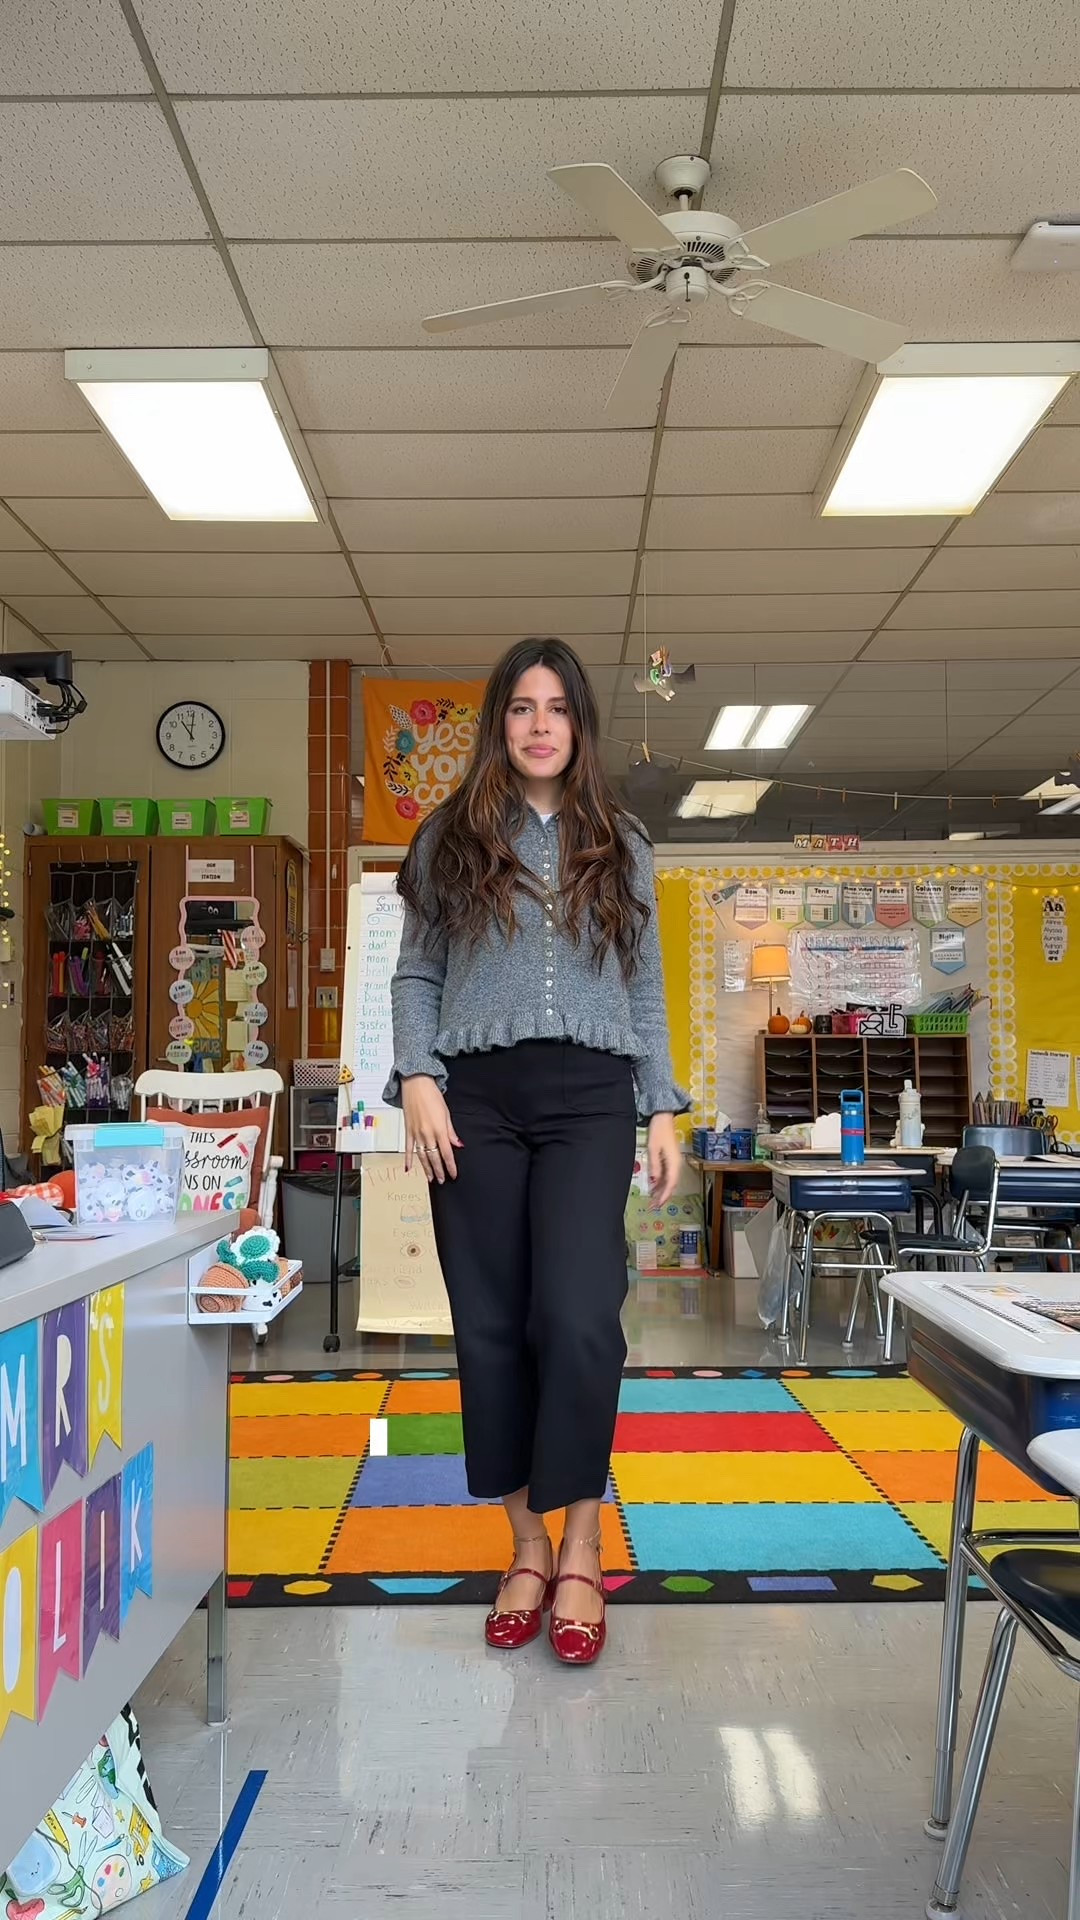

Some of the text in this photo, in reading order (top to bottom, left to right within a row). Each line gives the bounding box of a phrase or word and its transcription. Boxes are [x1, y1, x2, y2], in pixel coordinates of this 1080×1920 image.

[201, 712, 204, 720] 1
[208, 720, 214, 728] 2
[165, 732, 172, 740] 9
[212, 731, 217, 739] 3
[169, 743, 175, 751] 8
[209, 743, 215, 751] 4
[178, 751, 183, 759] 7
[413, 782, 450, 805] ca
[795, 837, 858, 848] MATH
[814, 887, 830, 895] Tens
[879, 887, 904, 895] Predict
[949, 885, 979, 893] Organize
[1043, 900, 1064, 912] Aa
[368, 929, 397, 938] mom
[368, 939, 387, 951] dad
[366, 955, 389, 964] mom
[360, 1032, 380, 1043] dad
[359, 1044, 378, 1056] dad
[190, 1131, 216, 1143] THIS
[202, 1175, 222, 1190] ON
[387, 1191, 422, 1201] Knees
[0, 1314, 114, 1482] MRS
